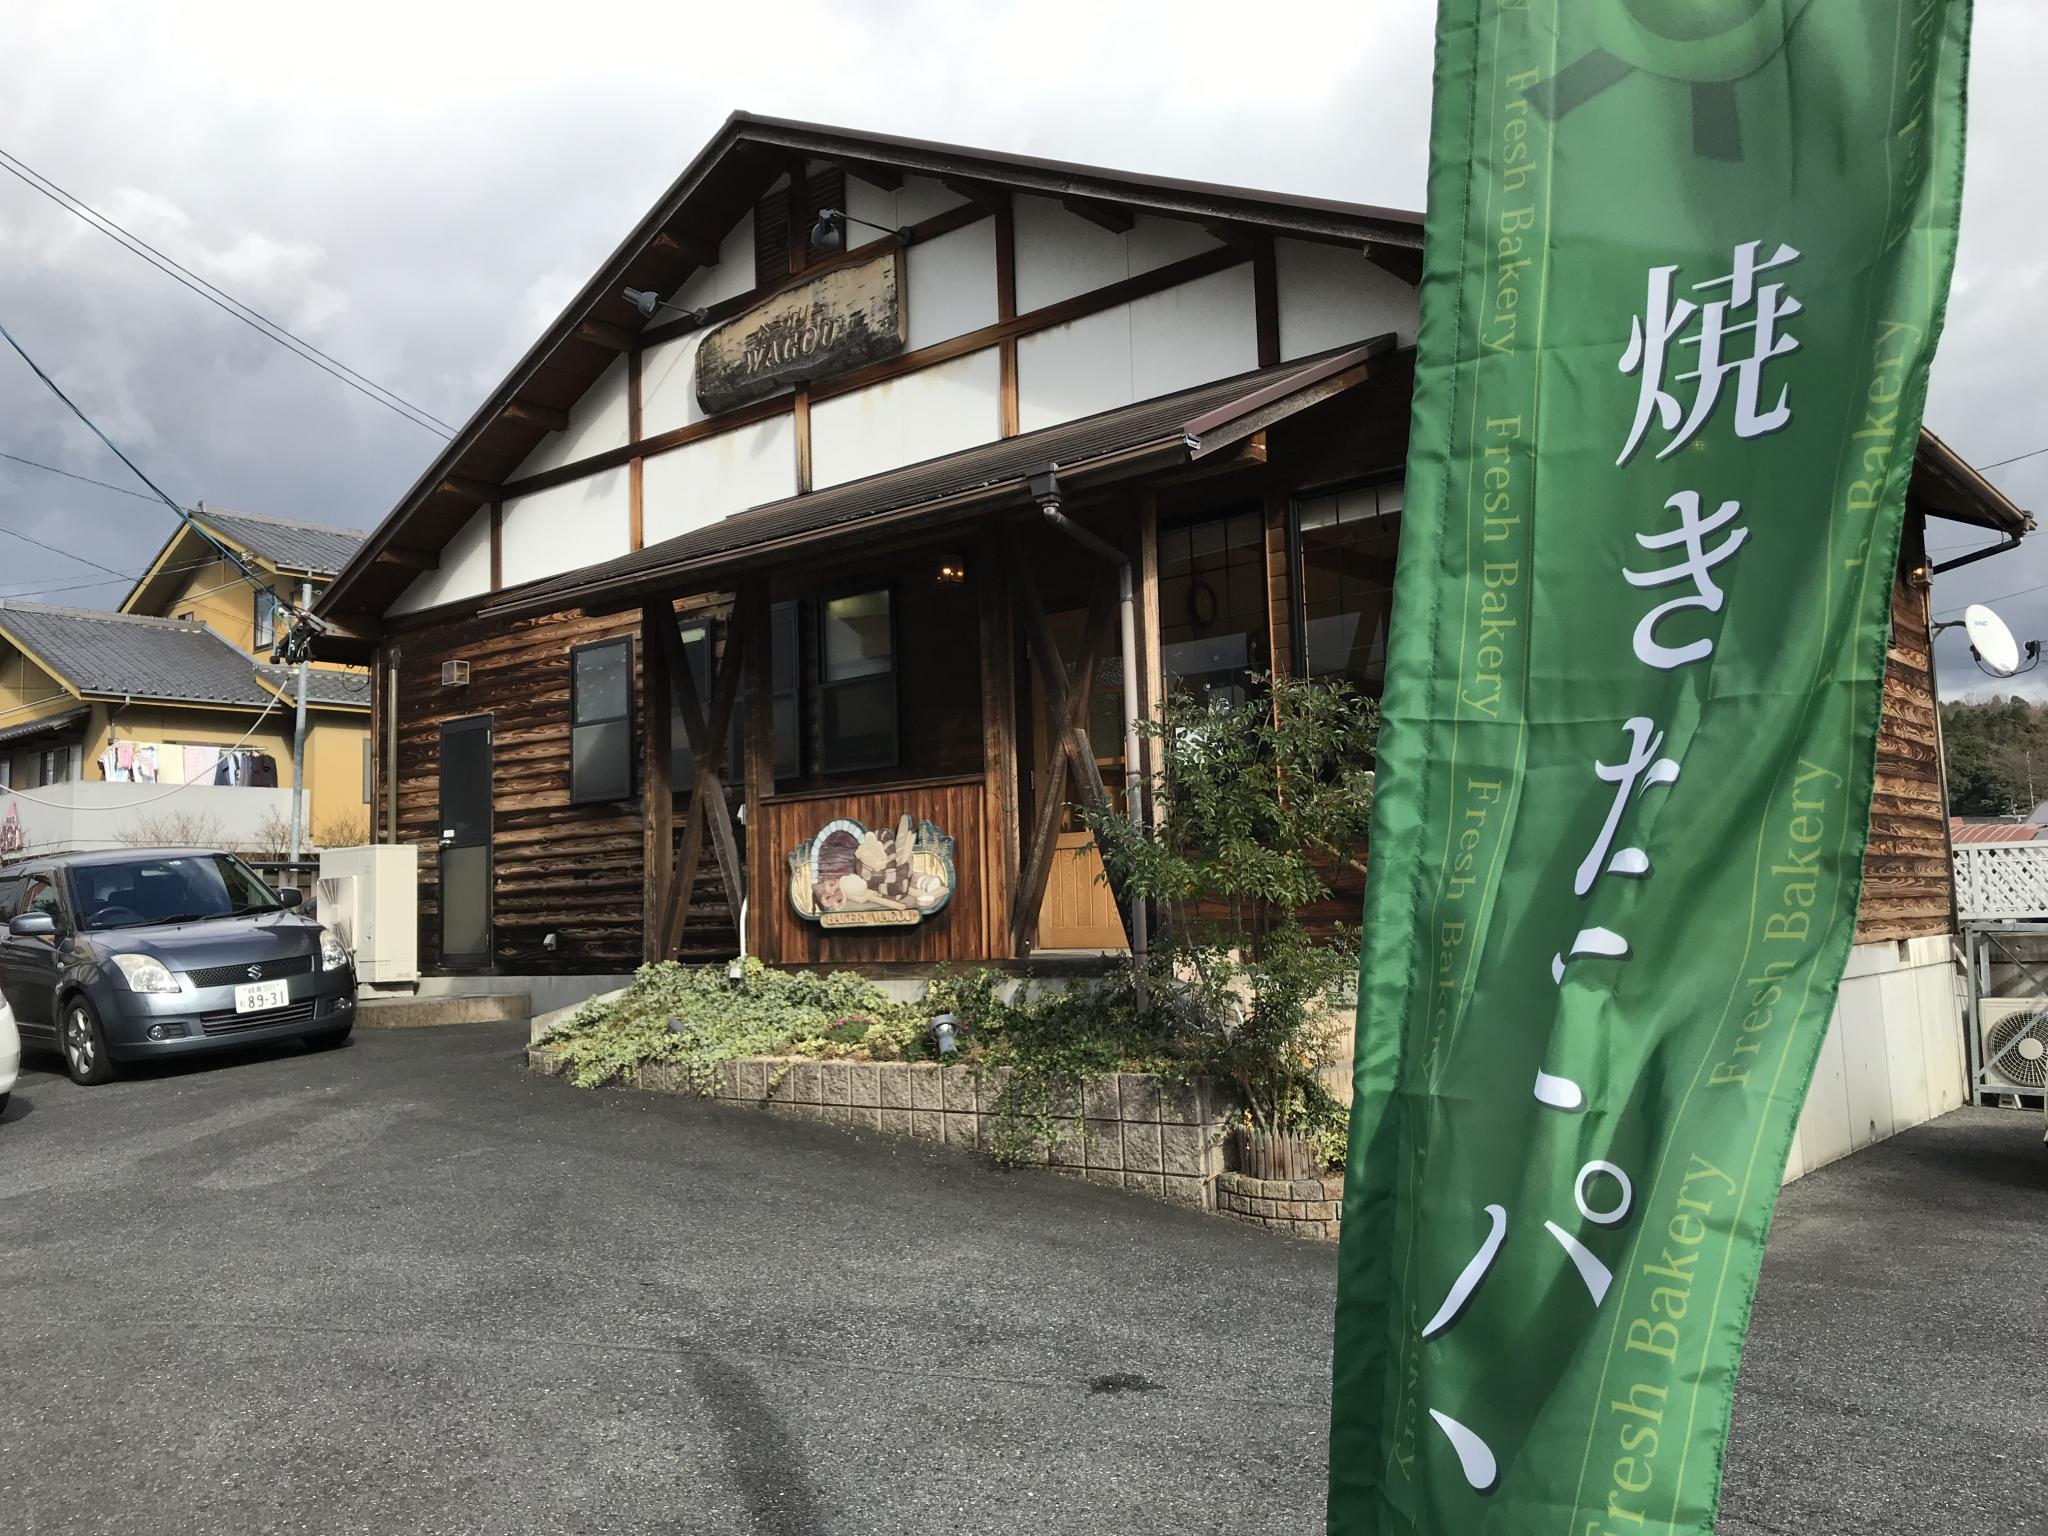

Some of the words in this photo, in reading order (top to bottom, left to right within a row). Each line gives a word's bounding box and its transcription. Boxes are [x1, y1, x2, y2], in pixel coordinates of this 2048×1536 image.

[1482, 206, 1535, 355] Bakery
[1483, 414, 1521, 544] Fresh
[1846, 319, 1922, 514] Bakery
[1461, 560, 1519, 719] Bakery
[1446, 778, 1502, 900] Fresh
[1706, 958, 1797, 1089] Fresh
[1763, 757, 1843, 943] Bakery
[248, 991, 284, 1009] 89-31
[1624, 1152, 1737, 1365] Bakery
[1583, 1383, 1669, 1536] resh
